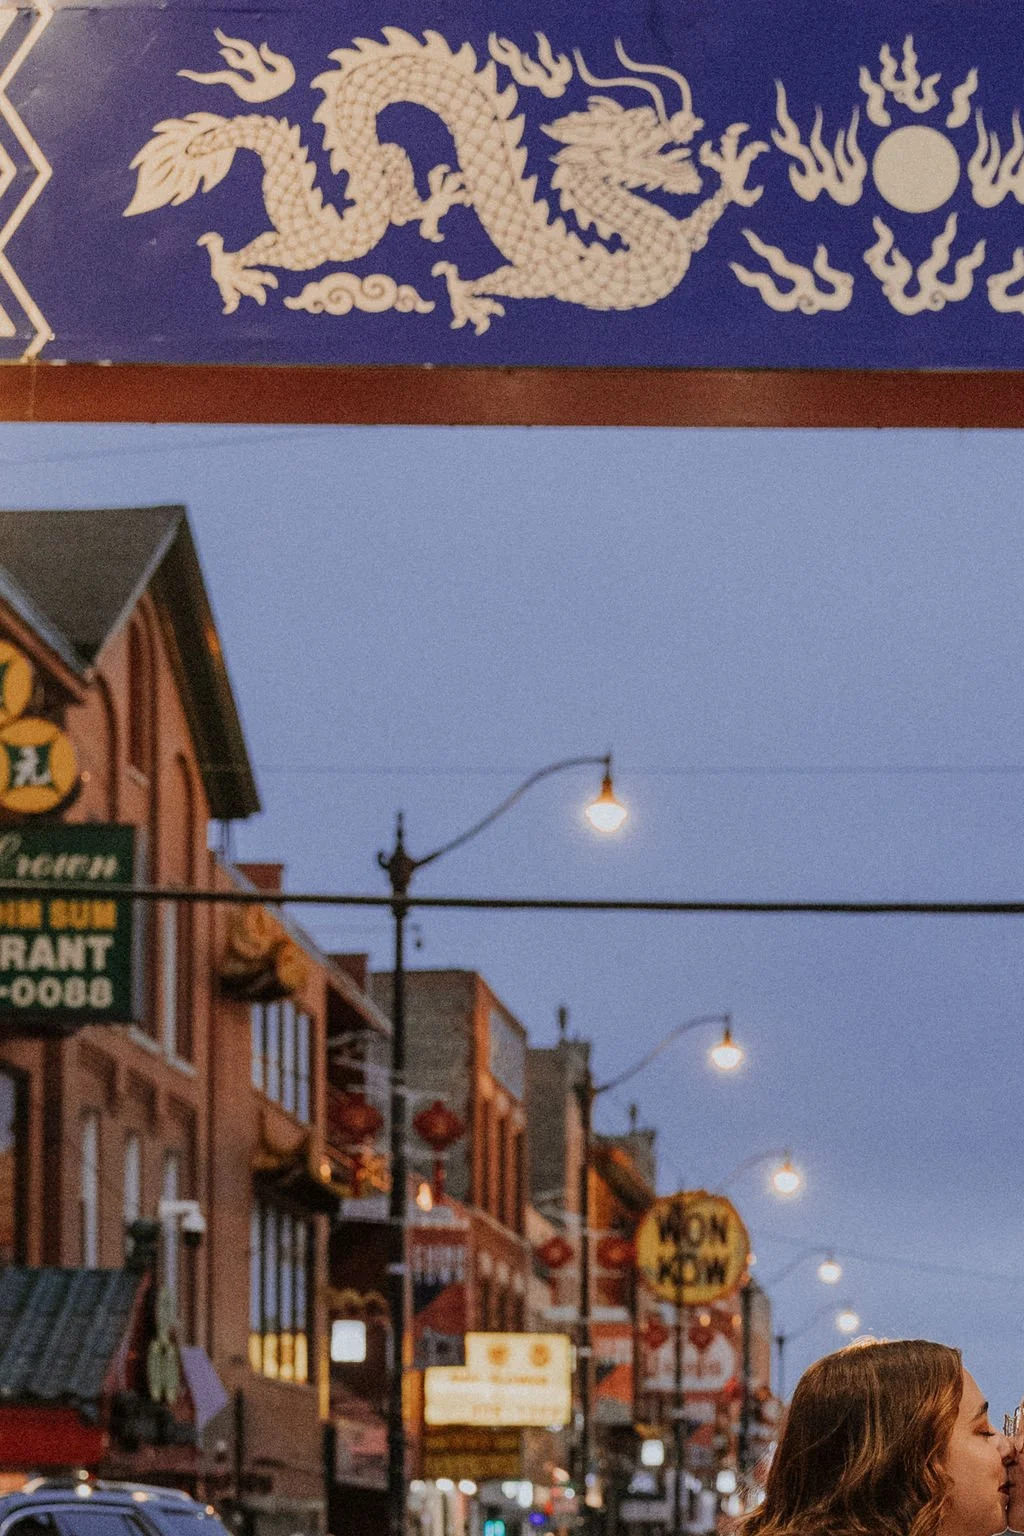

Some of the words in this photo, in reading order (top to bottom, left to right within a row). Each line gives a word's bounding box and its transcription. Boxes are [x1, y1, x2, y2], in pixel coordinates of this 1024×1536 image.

[0, 899, 42, 929] IM
[50, 899, 117, 929] SUM
[0, 934, 114, 971] RANT
[656, 1207, 729, 1246] WON
[656, 1254, 730, 1287] KOW
